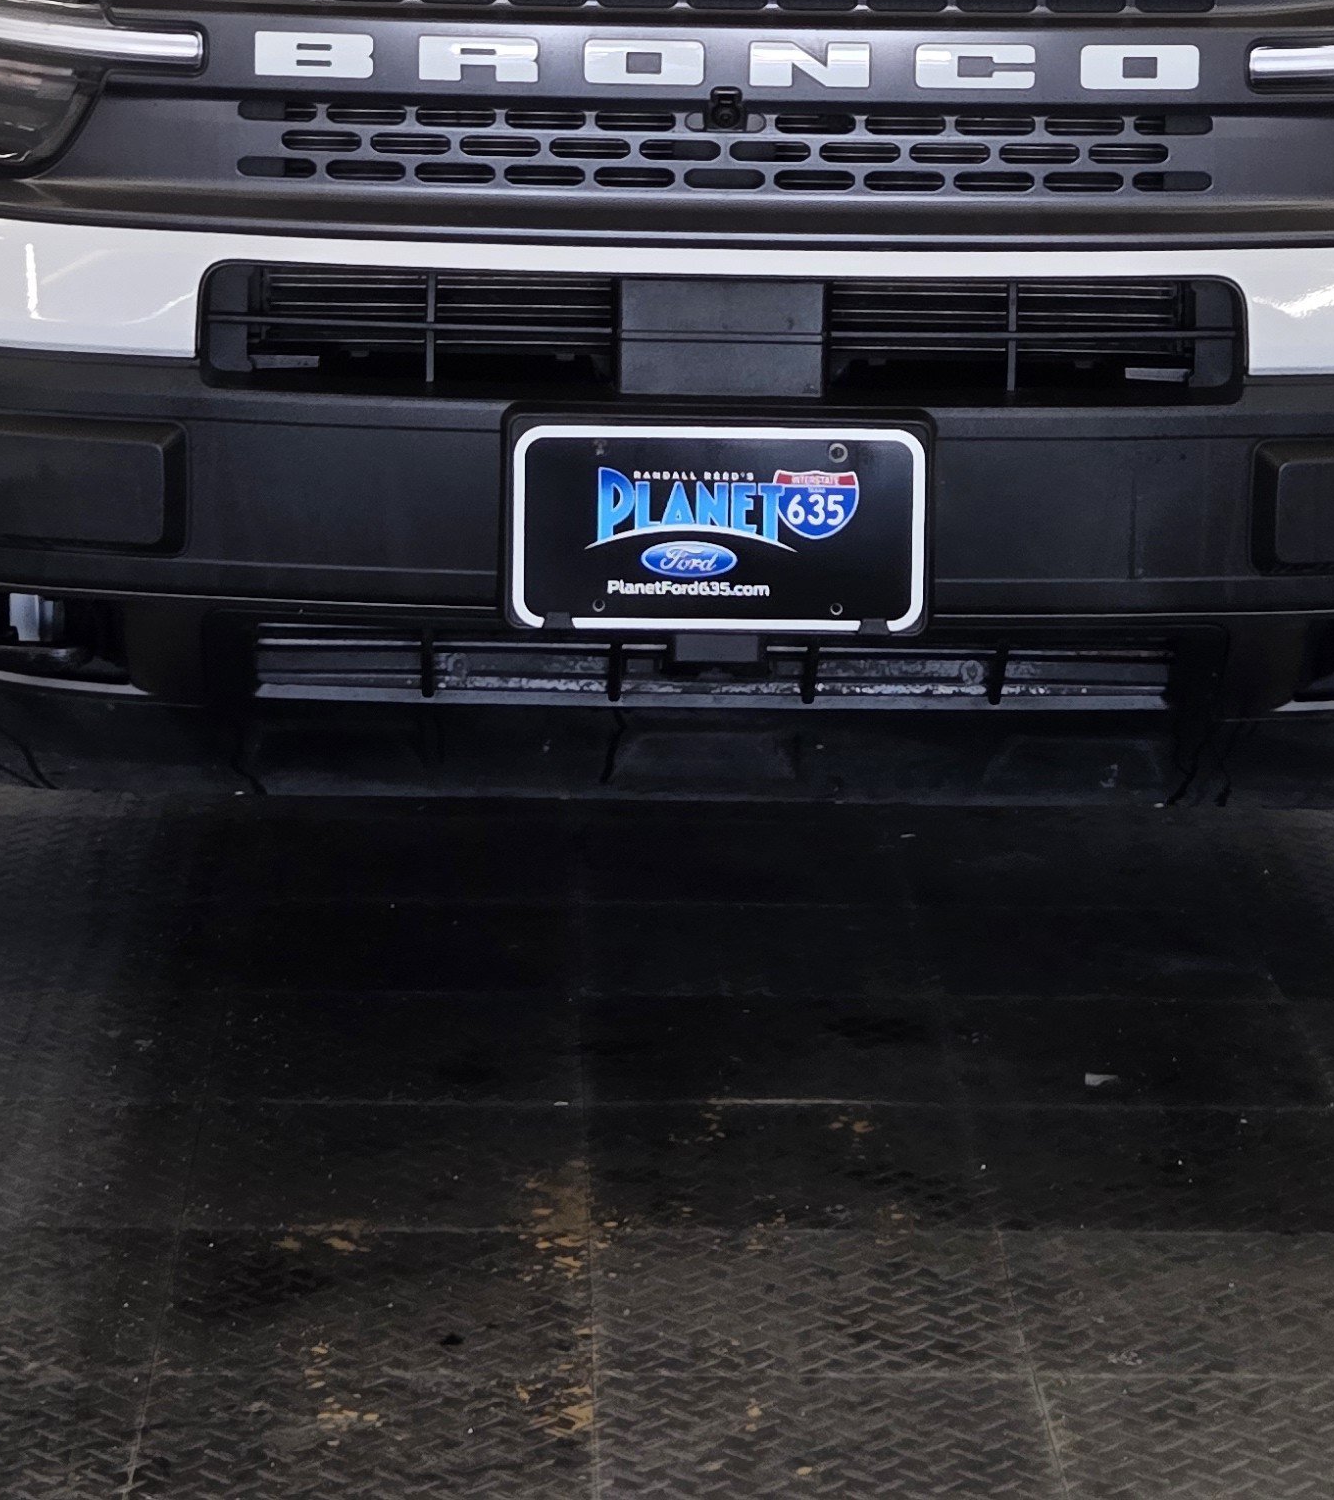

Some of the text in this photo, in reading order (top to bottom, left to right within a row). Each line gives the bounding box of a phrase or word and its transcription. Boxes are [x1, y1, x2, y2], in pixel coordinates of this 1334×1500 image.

[254, 29, 1200, 90] BRONCO
[633, 470, 697, 480] RANDALL
[598, 466, 785, 541] PLANET
[787, 494, 844, 525] 635
[659, 549, 718, 572] Ford
[607, 579, 770, 597] PlanetFord635.com
